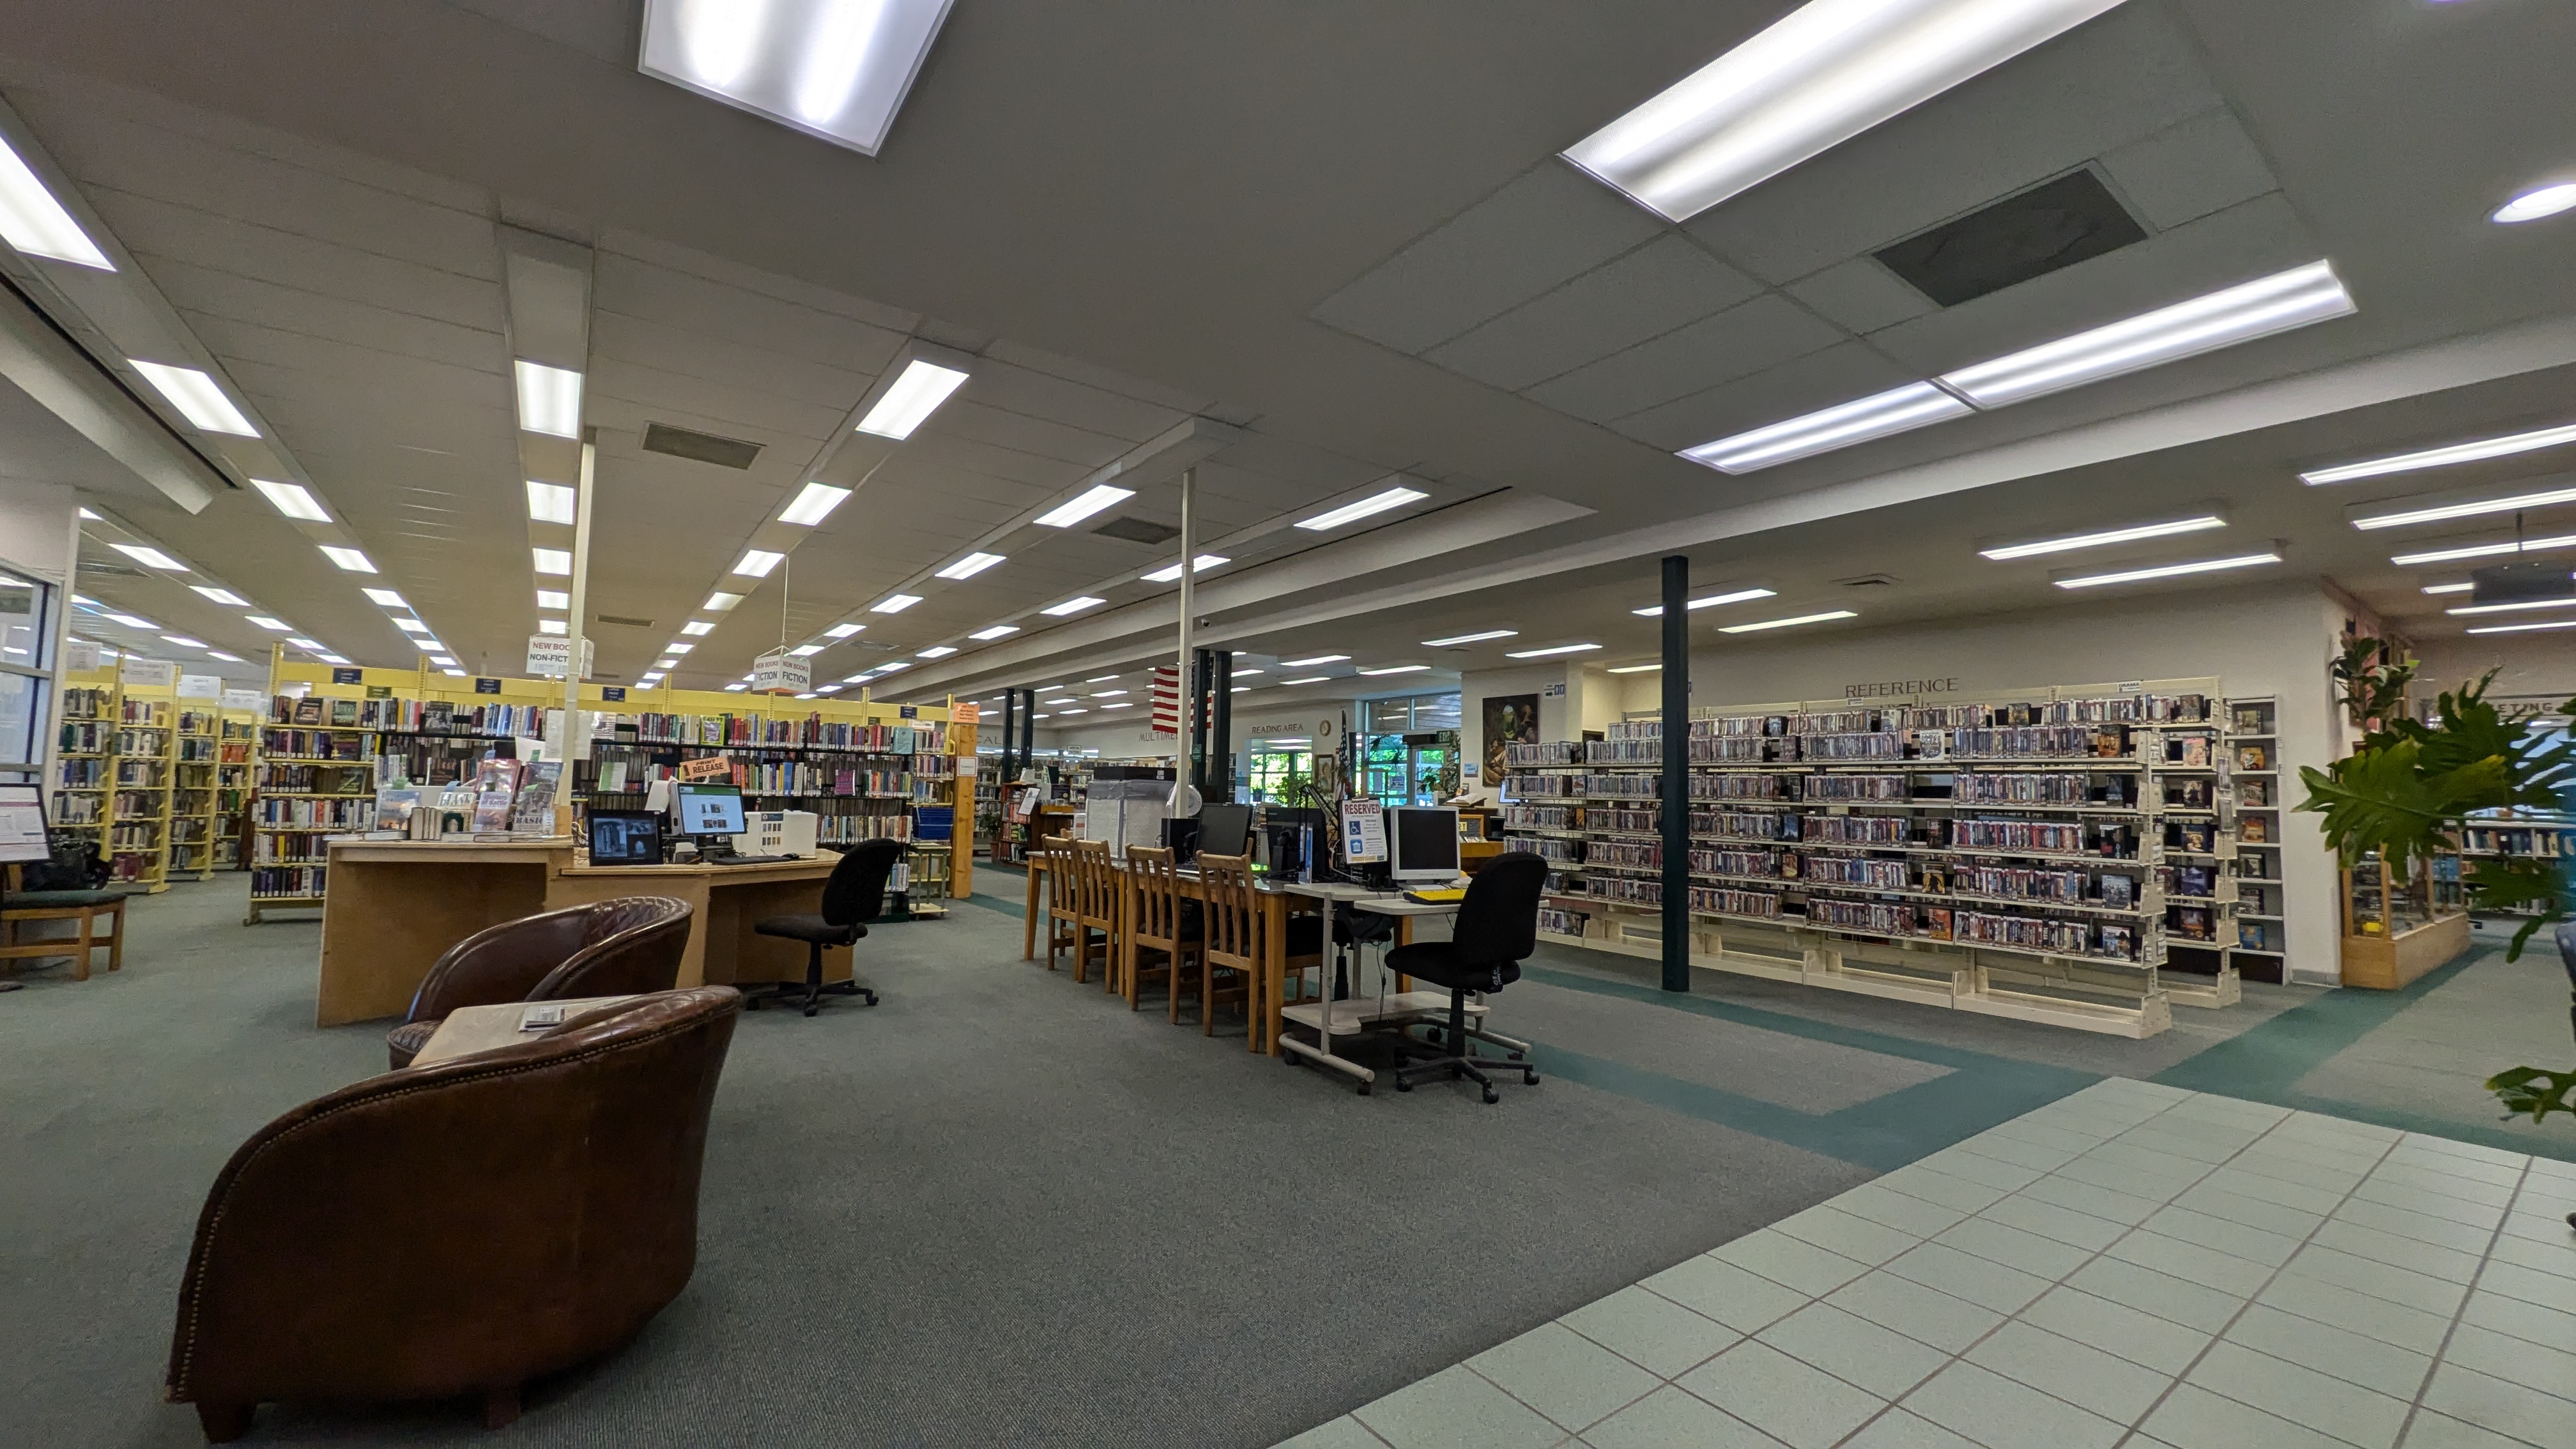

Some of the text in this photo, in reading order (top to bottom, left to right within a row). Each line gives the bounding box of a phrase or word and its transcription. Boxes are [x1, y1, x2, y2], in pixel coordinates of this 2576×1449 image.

[530, 653, 581, 663] NON-FICT
[783, 660, 808, 672] NEW BOOKS
[756, 671, 778, 682] FICTION
[783, 671, 808, 685] FICTION
[1846, 678, 1959, 698] REFERENCE
[2498, 702, 2553, 713] ETING
[1252, 723, 1304, 734] READING AREA
[1138, 732, 1178, 742] MULTIME
[693, 762, 724, 774] RELEASE
[1344, 803, 1381, 815] RESERVED
